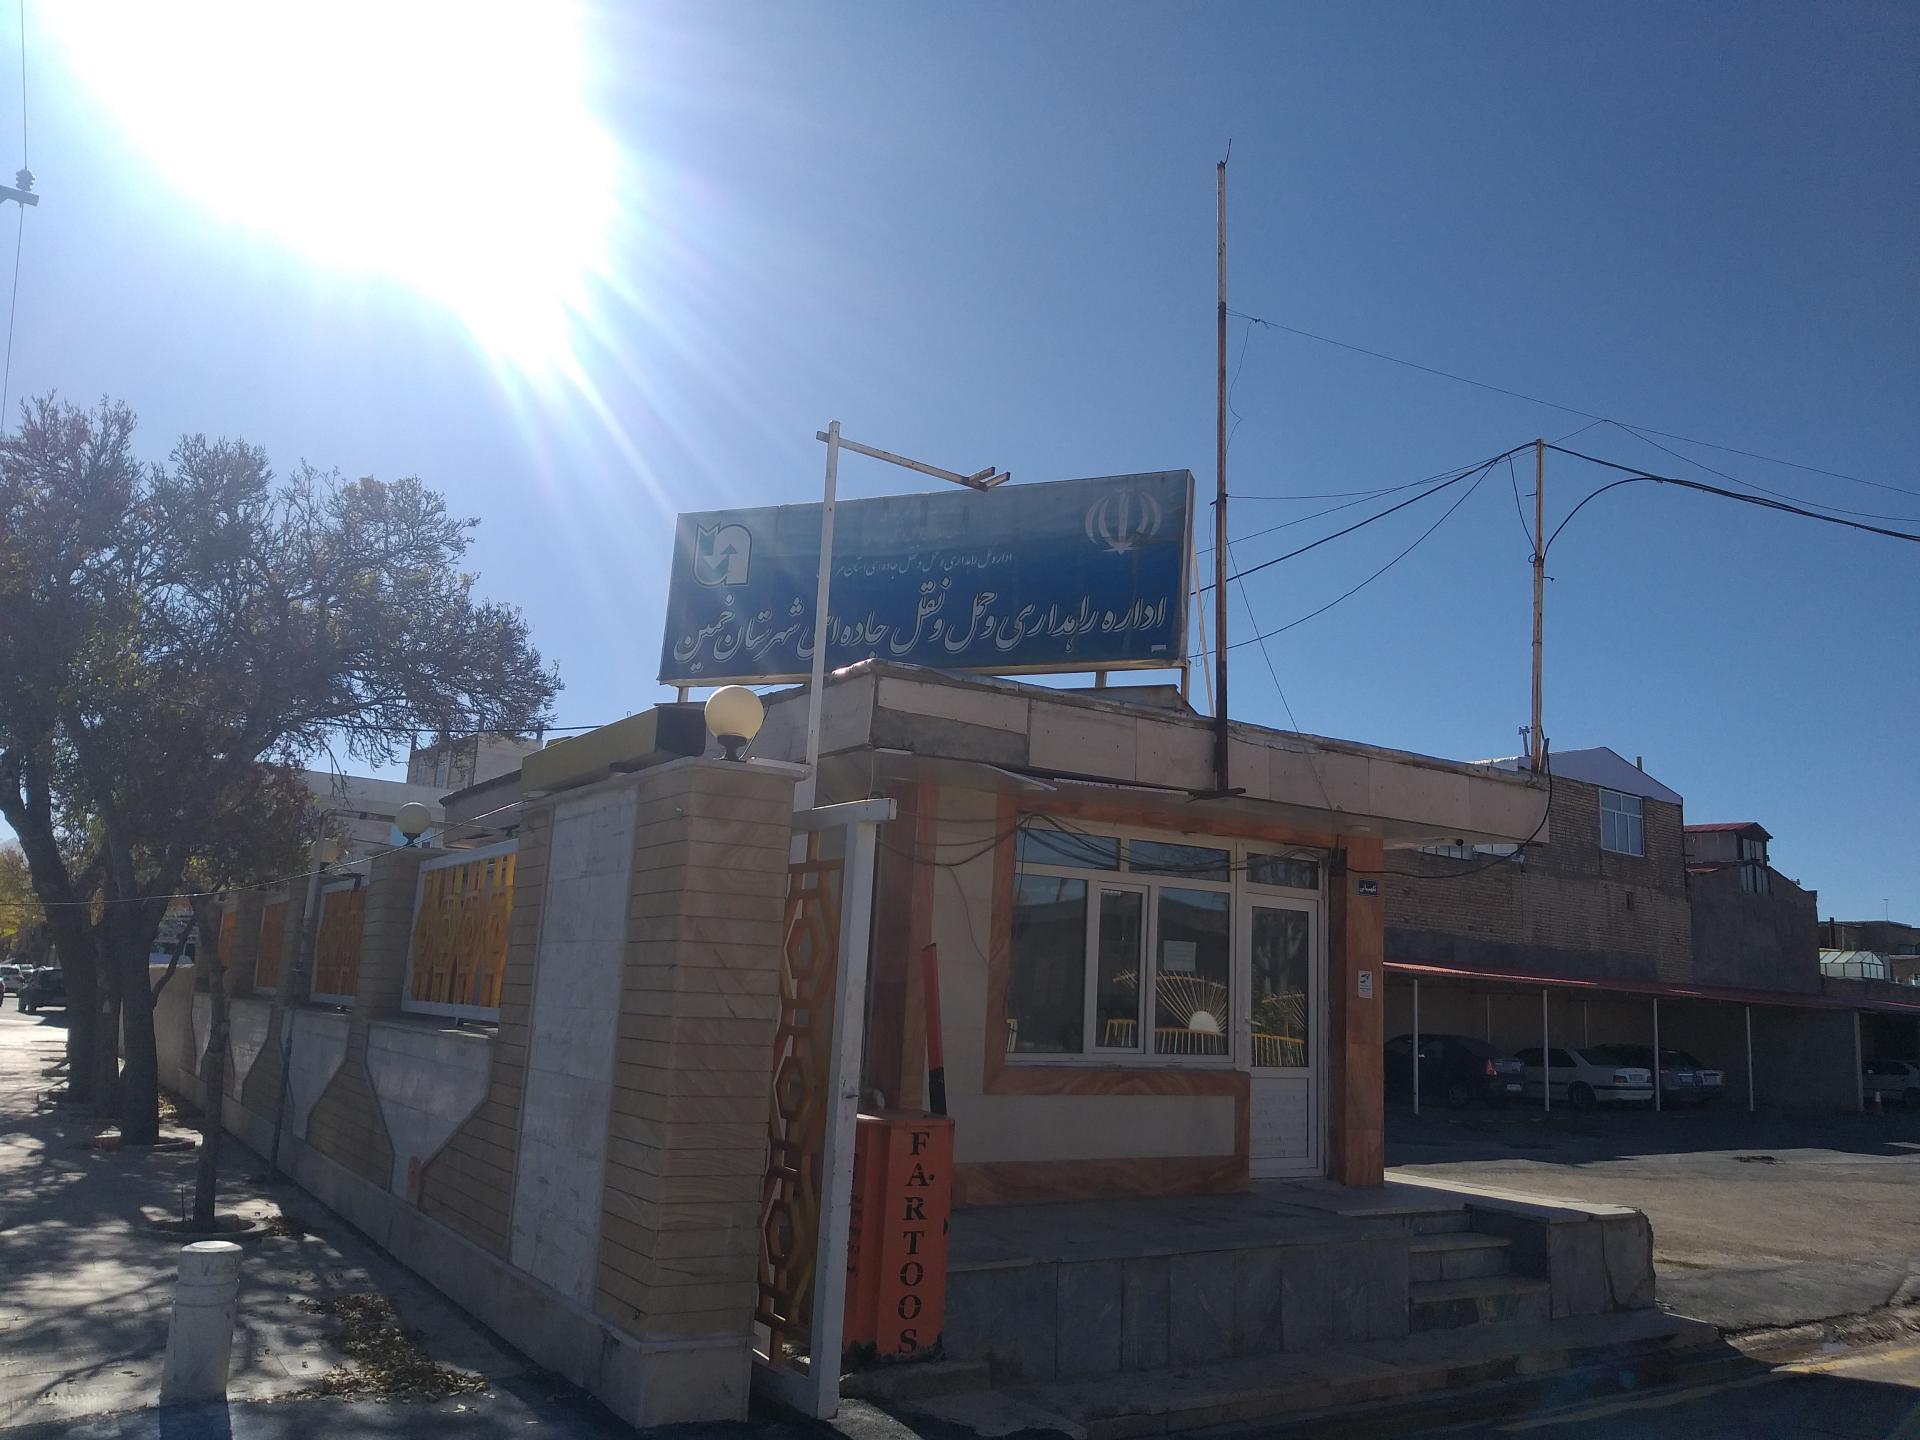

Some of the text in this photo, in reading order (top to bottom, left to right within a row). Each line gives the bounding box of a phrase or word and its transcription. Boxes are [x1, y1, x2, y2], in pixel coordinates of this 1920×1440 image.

[944, 554, 978, 573] راهداری
[673, 594, 736, 673] خمین
[713, 597, 804, 663] شهرستان
[841, 610, 890, 658] جاده
[889, 576, 952, 656] نقل
[996, 594, 1100, 653] راهداری
[1101, 596, 1167, 632] اداره
[898, 1131, 930, 1354] FARTOOS
